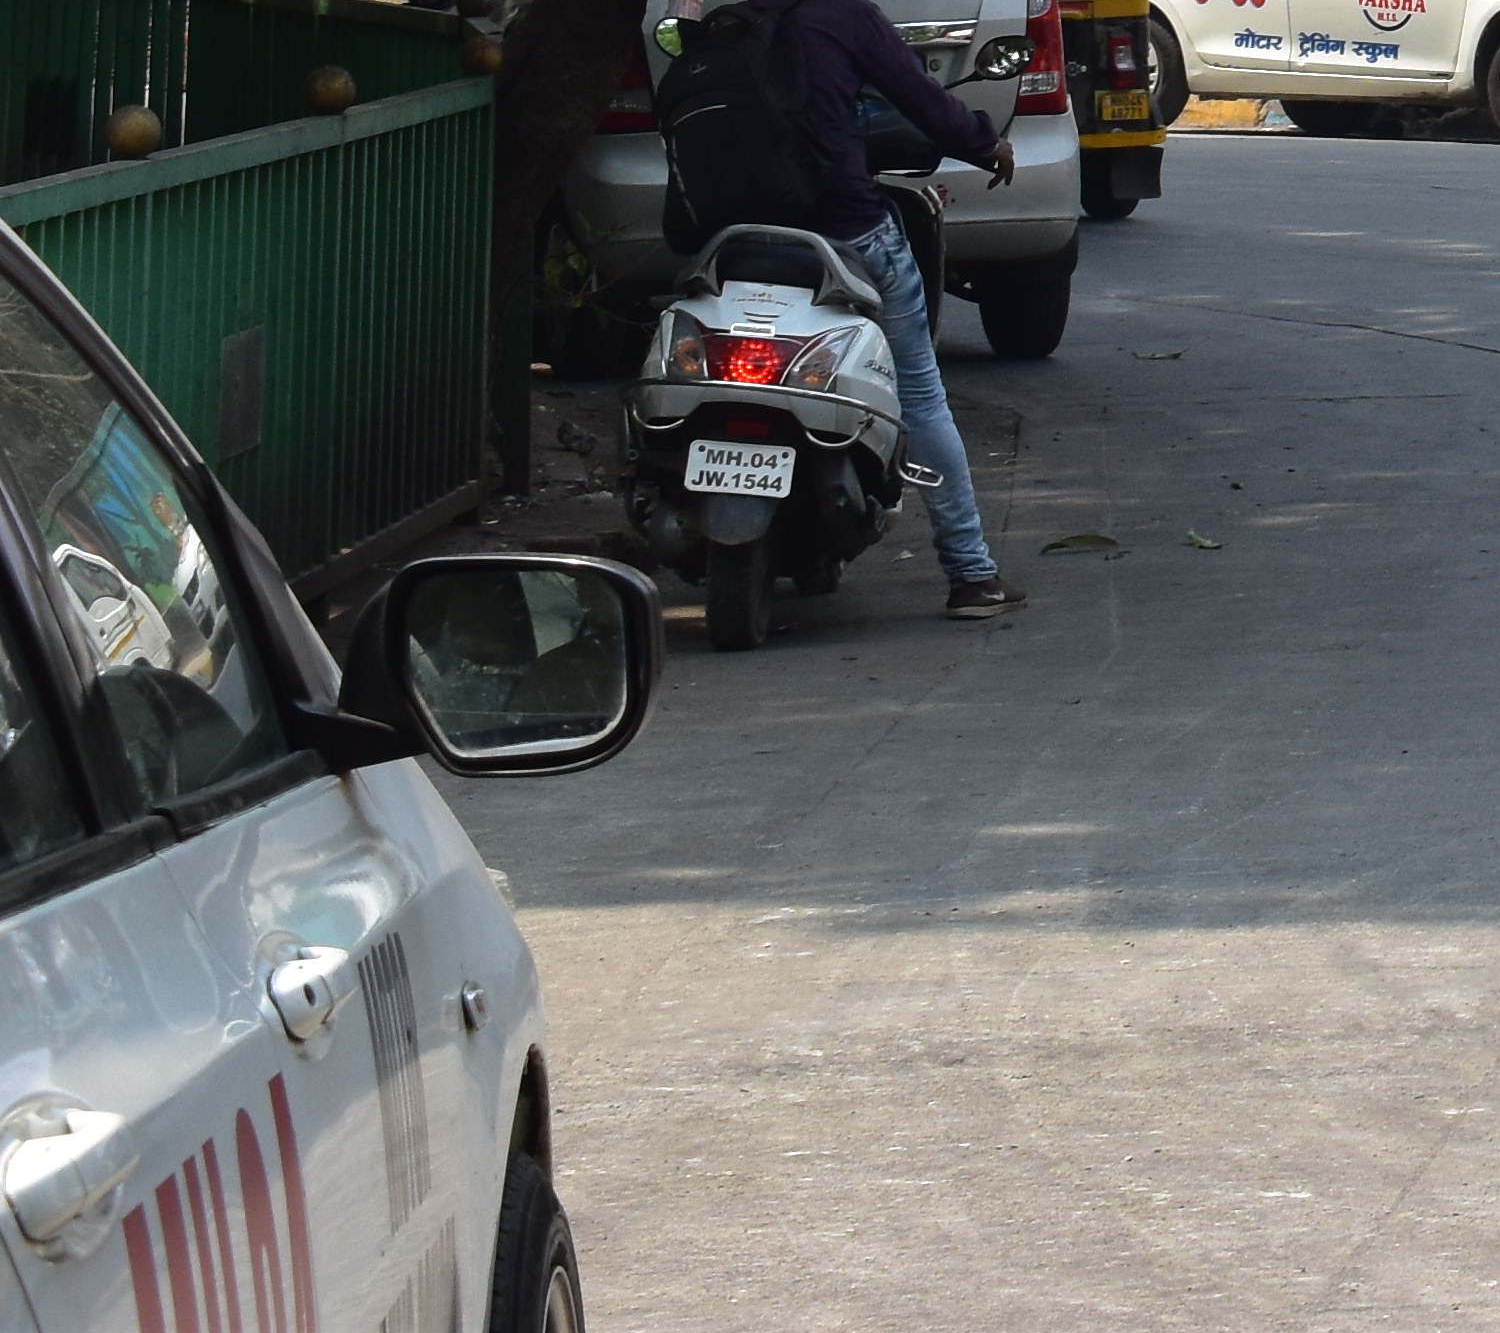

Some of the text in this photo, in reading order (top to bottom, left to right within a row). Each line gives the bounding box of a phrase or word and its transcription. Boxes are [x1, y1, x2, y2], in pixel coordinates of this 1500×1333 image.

[1234, 28, 1284, 51] मोटार
[1297, 32, 1347, 59] ट्रेनिंग
[704, 448, 779, 470] MH.04
[691, 469, 784, 493] JW.1544
